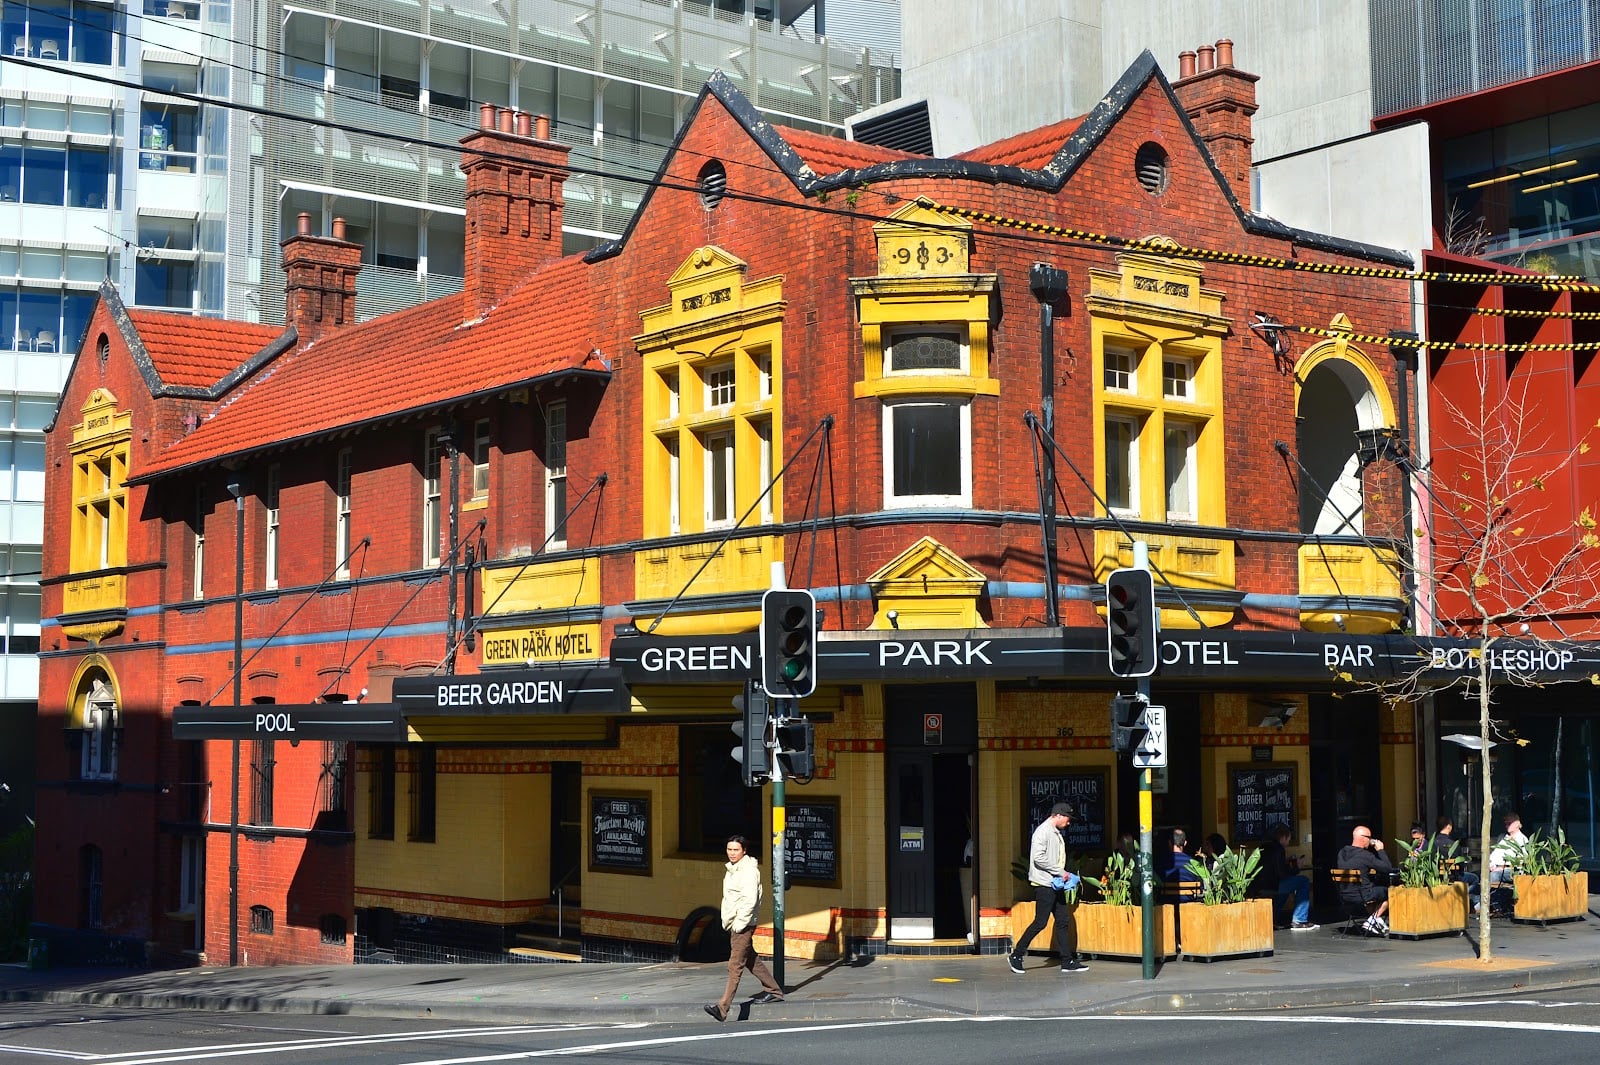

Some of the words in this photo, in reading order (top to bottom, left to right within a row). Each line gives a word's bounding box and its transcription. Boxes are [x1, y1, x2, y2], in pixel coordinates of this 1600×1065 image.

[529, 629, 547, 637] THE
[485, 638, 519, 660] GREEN
[522, 635, 552, 658] PARK
[641, 645, 751, 672] GREEN
[879, 640, 993, 667] PARK
[1324, 644, 1374, 667] BAR
[437, 684, 483, 706] BEER
[486, 680, 563, 705] GARDEN
[255, 713, 296, 732] POOL
[1146, 730, 1162, 744] AY
[1031, 780, 1060, 796] HAPPY
[1071, 780, 1097, 794] HOUR
[1237, 794, 1263, 806] BURGER
[612, 803, 628, 812] FREE
[1237, 811, 1263, 822] BLONDE
[902, 840, 921, 849] ATM
